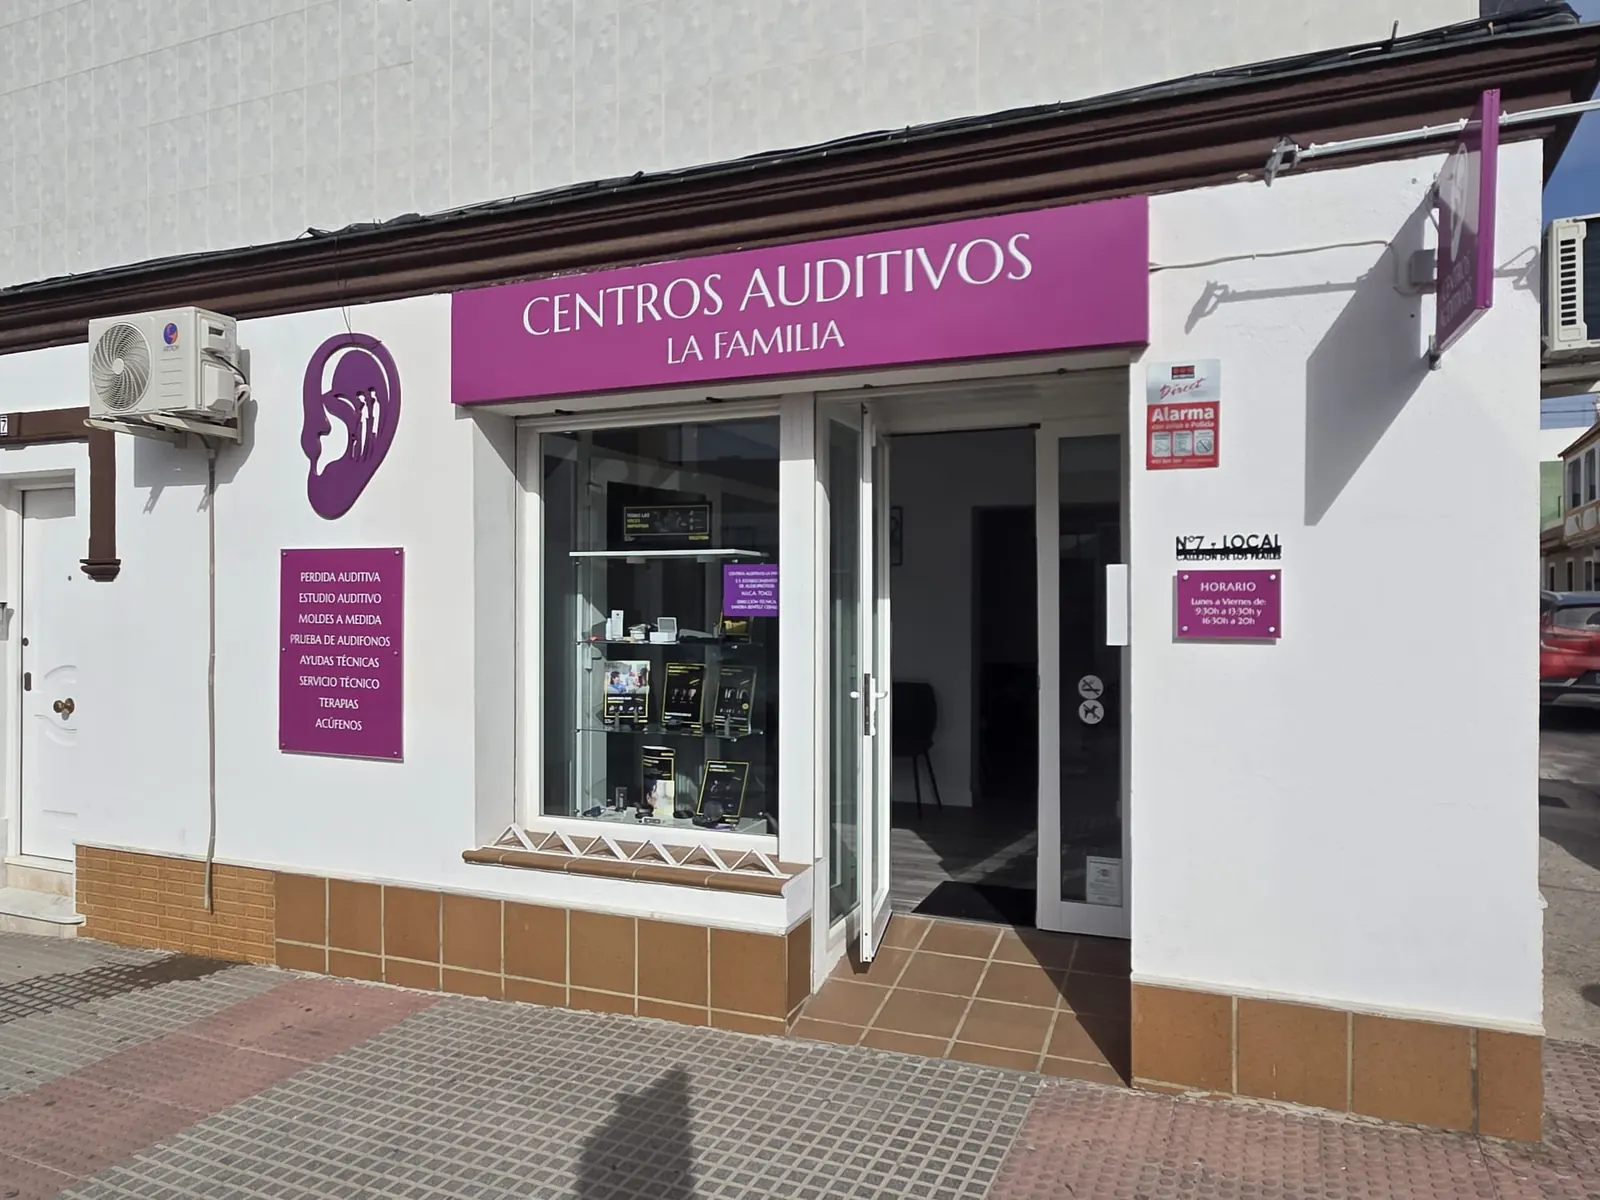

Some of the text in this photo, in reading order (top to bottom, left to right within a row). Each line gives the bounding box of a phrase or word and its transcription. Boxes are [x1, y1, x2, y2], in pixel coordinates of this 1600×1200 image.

[522, 233, 1033, 336] CENTROS AUDITIVOS
[667, 319, 846, 365] LA FAMILIA
[1151, 406, 1215, 422] Alarma
[1223, 533, 1282, 549] LOCAL
[300, 571, 381, 582] PERDIDA AUDITIVA
[1200, 581, 1257, 592] HORARIO
[298, 592, 382, 604] ESTUDIO AUDITIVO
[1191, 597, 1214, 606] Lunes
[1221, 597, 1252, 606] Viernes
[298, 613, 382, 625] MOLDES A MEDIDA
[1256, 608, 1263, 617] y
[1237, 616, 1255, 625] 20h
[289, 633, 391, 647] PRUEBA DE AUDIFONOS
[299, 654, 380, 668] AYUDAS TÉCNICAS
[299, 675, 380, 689] SERVICIO TÉCNICO
[318, 697, 359, 709] TERAPIAS
[315, 716, 363, 731] ACÚFENOS
